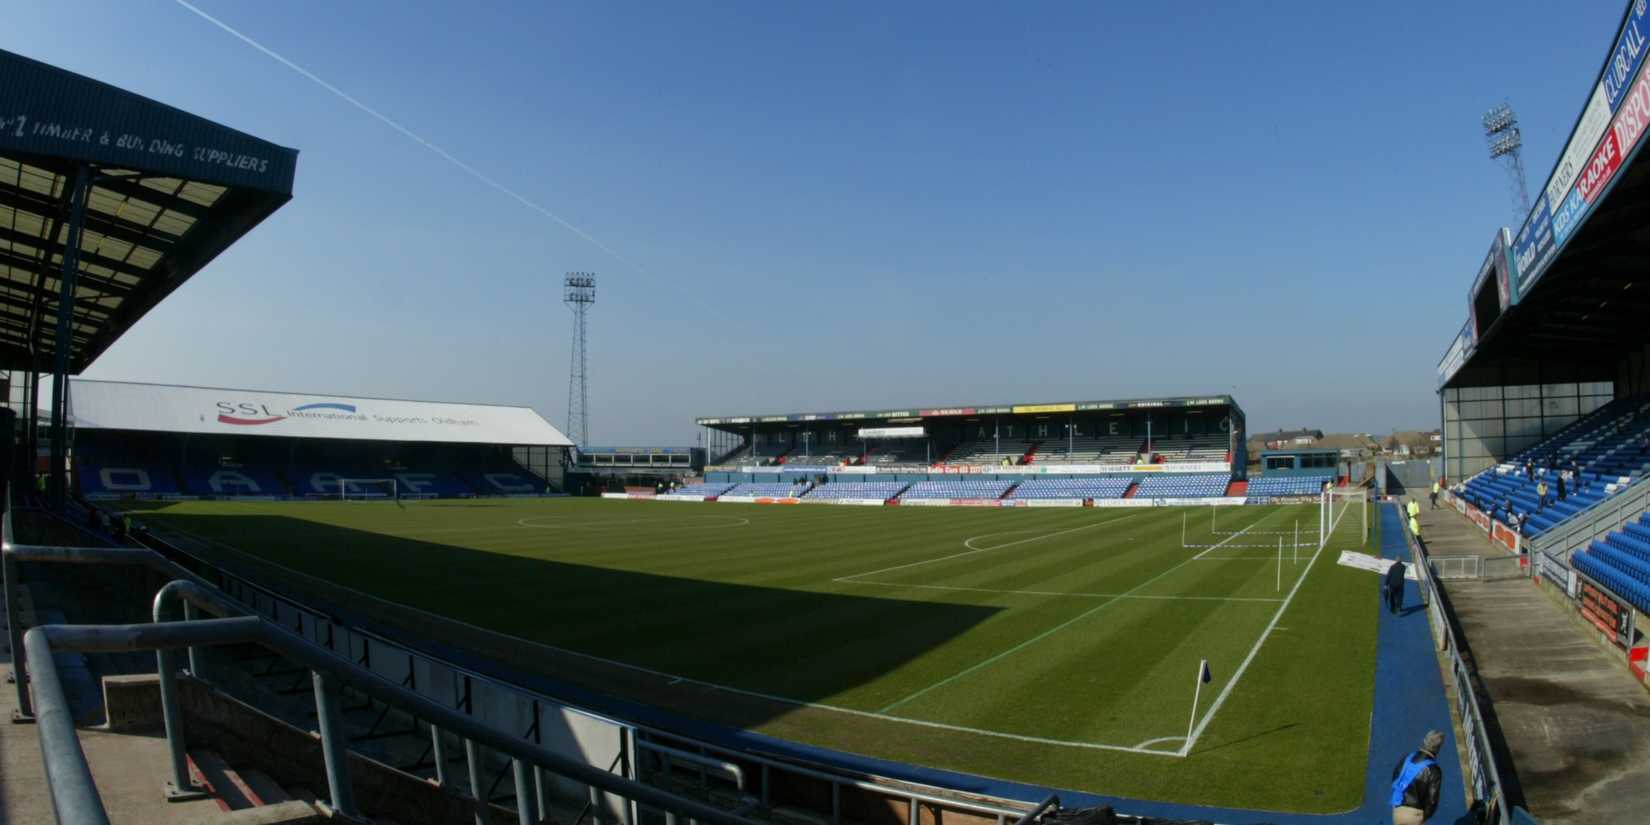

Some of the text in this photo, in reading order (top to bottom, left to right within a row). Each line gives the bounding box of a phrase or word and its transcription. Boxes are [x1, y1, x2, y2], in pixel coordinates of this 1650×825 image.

[1605, 20, 1645, 104] CLUBCALL
[192, 146, 269, 172] SUPPLIERS
[216, 400, 277, 416] SSL
[287, 409, 367, 422] International
